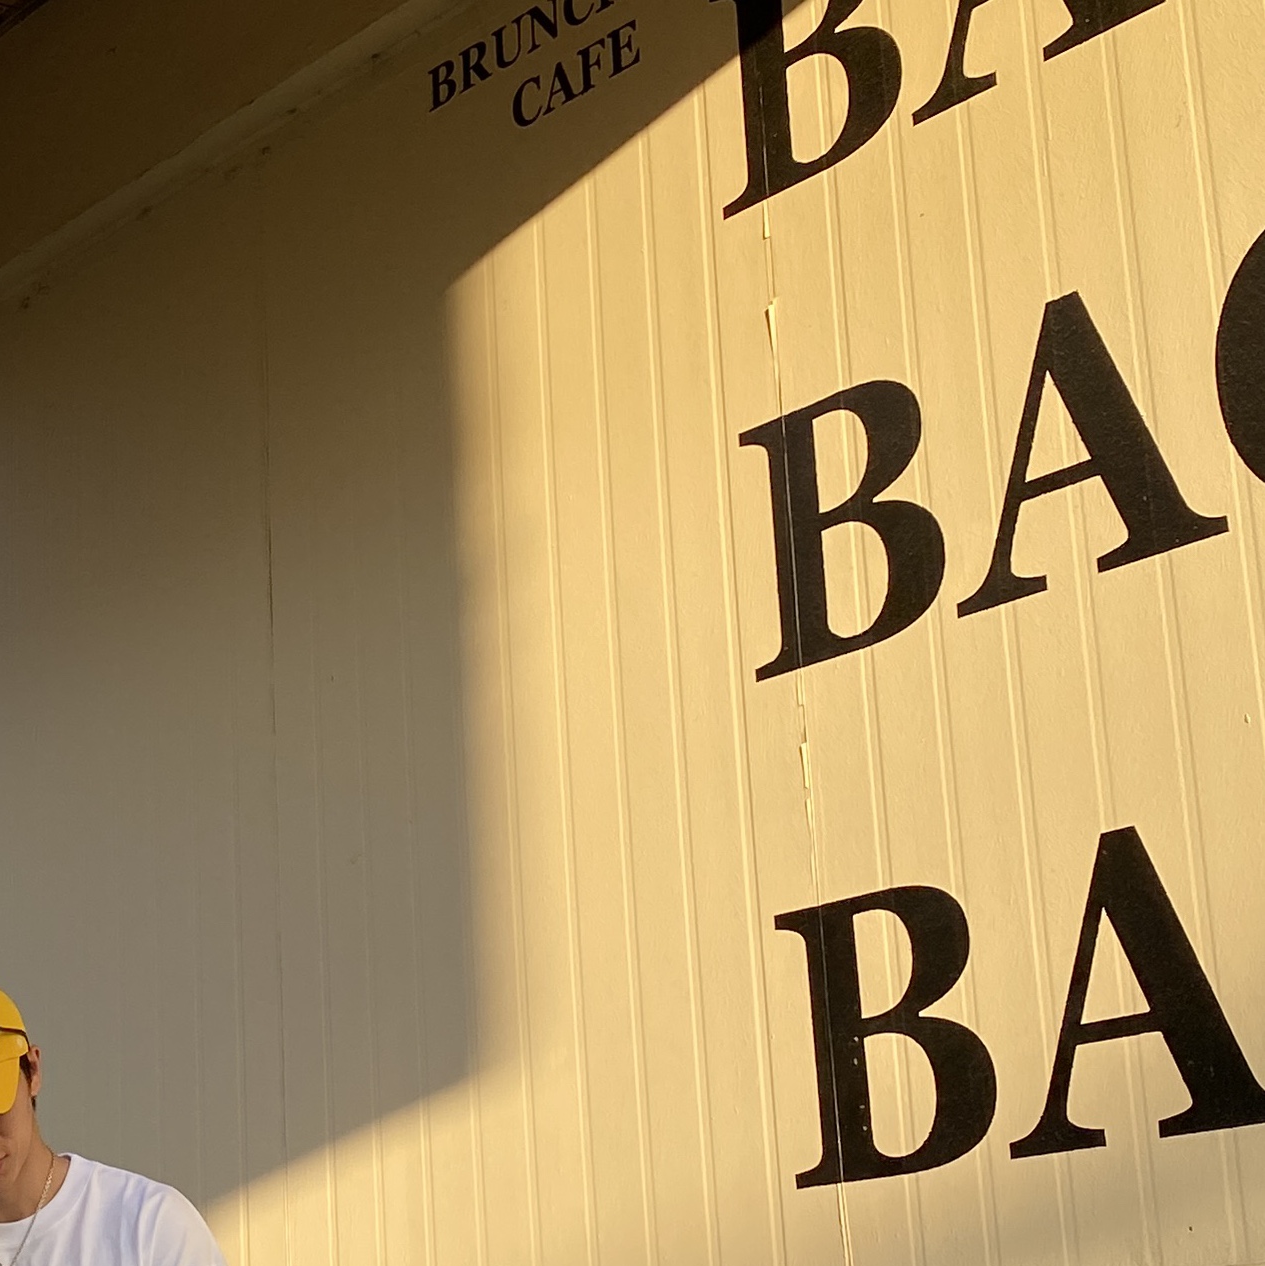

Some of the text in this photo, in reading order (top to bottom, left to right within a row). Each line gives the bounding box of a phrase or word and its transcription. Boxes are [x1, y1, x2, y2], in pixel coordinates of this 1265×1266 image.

[428, 0, 614, 112] BRUNC
[512, 19, 640, 127] CAFE
[739, 227, 1265, 682] BA
[774, 825, 1265, 1189] BA
